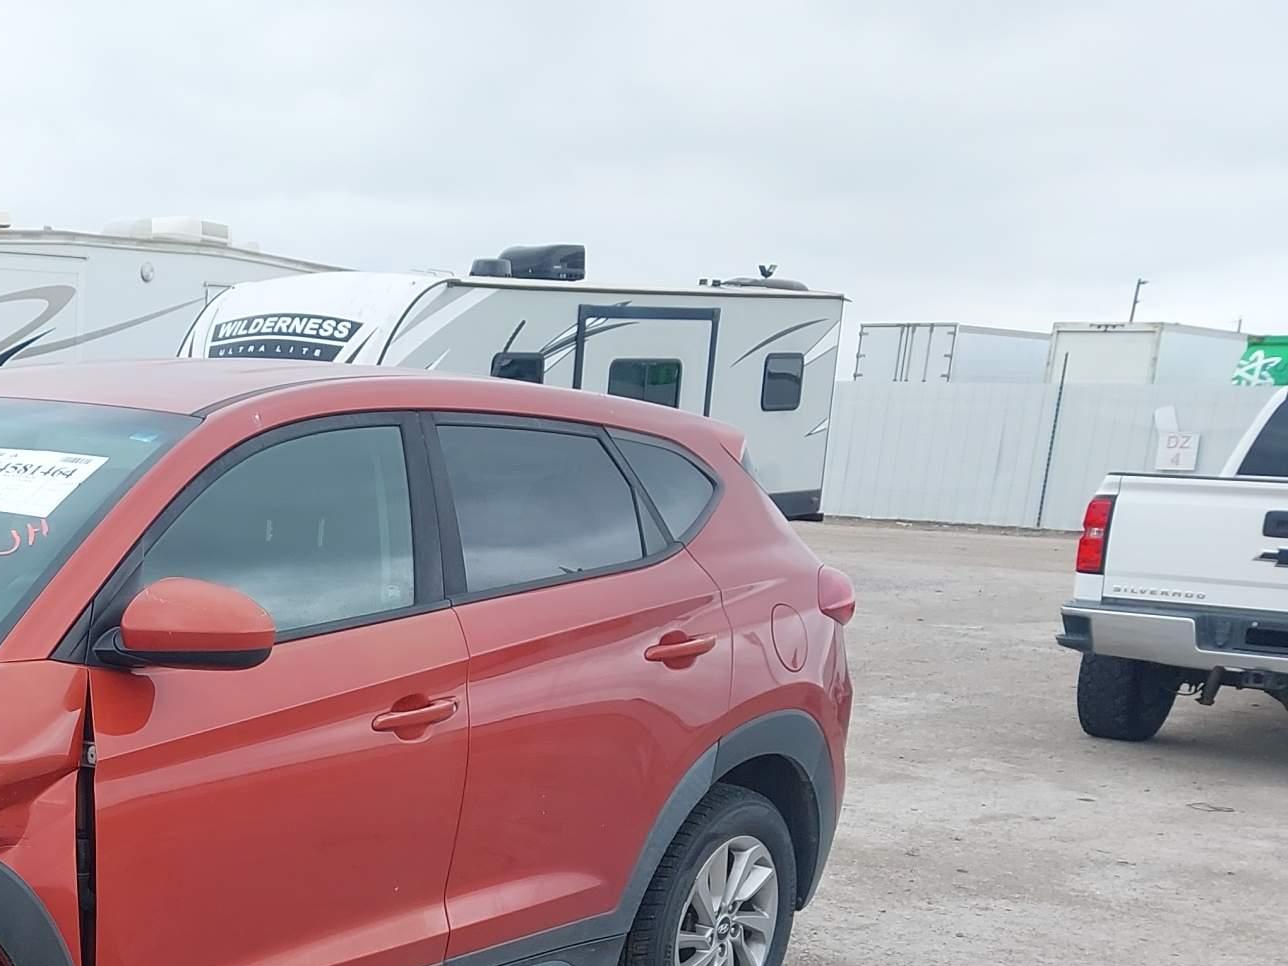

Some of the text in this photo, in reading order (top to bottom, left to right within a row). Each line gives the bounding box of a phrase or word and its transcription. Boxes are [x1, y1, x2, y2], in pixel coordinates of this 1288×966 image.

[217, 316, 353, 339] WILDERNESS
[219, 344, 322, 358] ULTRA LITE
[1112, 586, 1207, 600] SILVERADO
